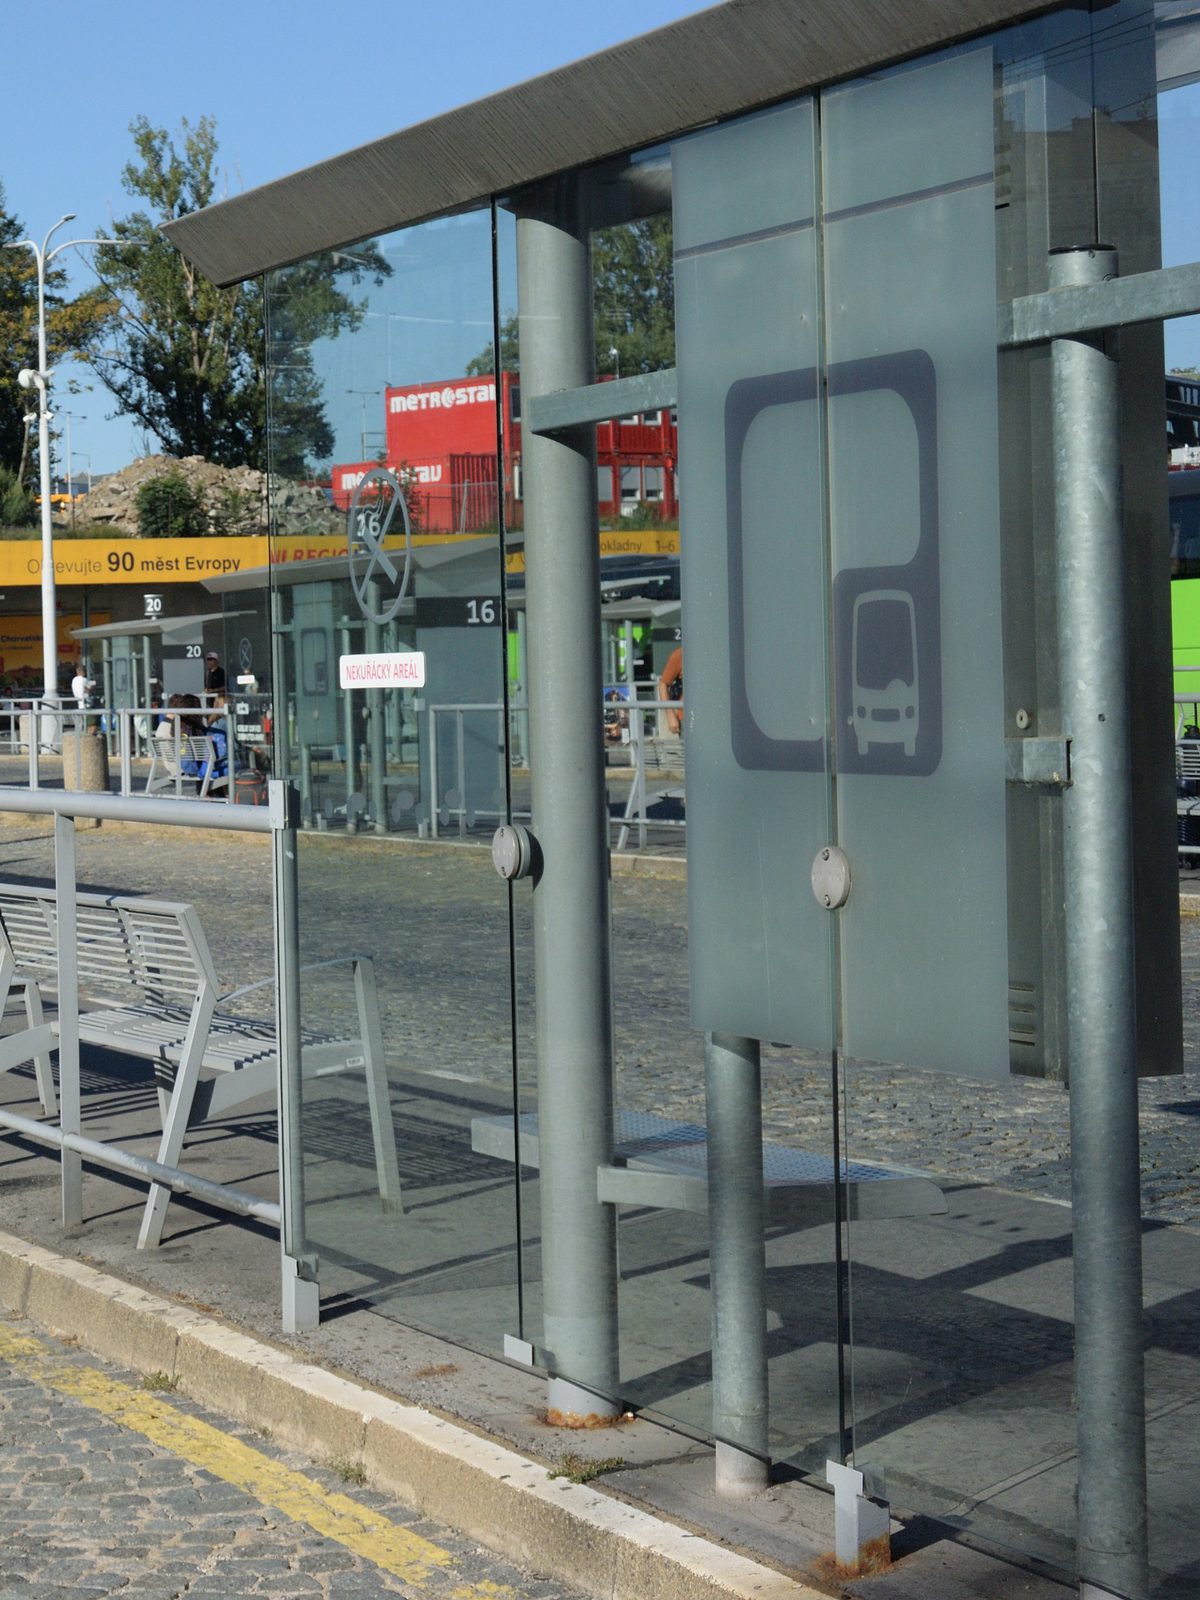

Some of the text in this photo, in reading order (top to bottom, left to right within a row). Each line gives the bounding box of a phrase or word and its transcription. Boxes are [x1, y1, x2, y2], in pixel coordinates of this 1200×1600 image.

[600, 540, 642, 553] okladny
[27, 552, 241, 576] Oevujte 90 měst Evropy
[146, 598, 162, 612] 20
[466, 599, 496, 624] 16
[186, 645, 202, 658] 20
[345, 658, 419, 681] NEKUŘÁCKÝ AREÁL
